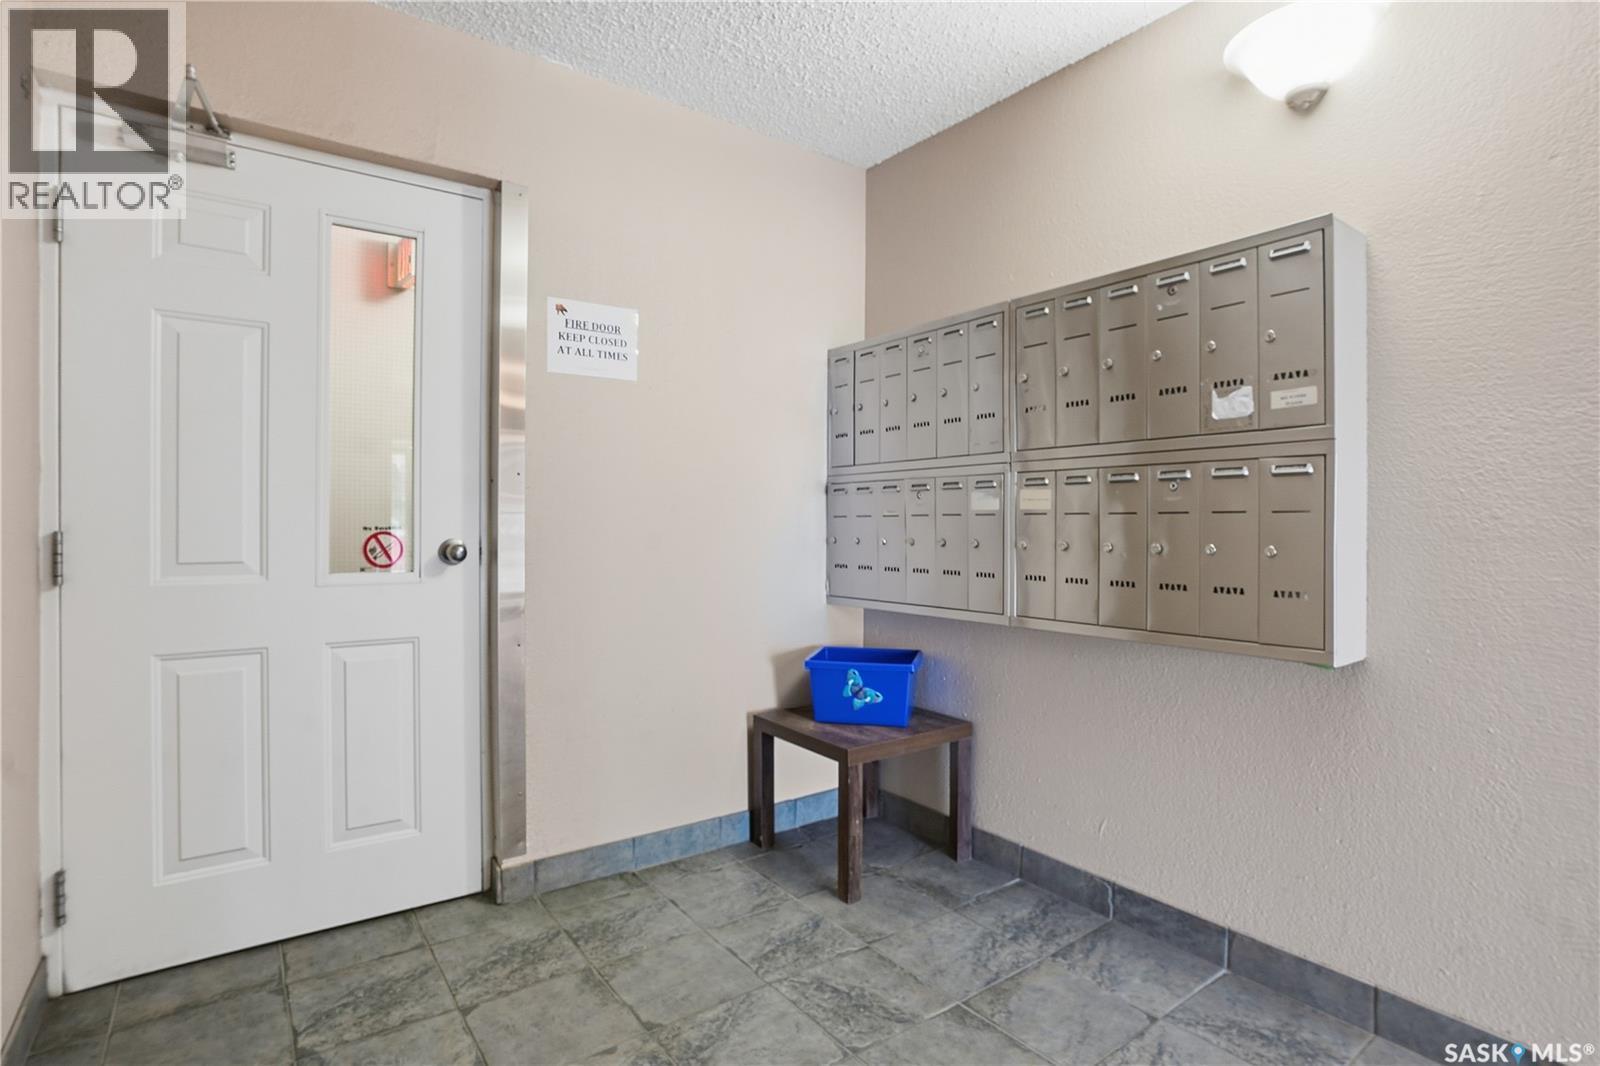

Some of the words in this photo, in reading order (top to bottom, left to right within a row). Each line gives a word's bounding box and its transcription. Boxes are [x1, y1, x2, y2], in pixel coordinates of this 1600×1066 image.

[565, 318, 590, 331] FIRE
[591, 321, 621, 335] DOOR
[558, 331, 586, 343] KEEP
[588, 335, 628, 348] CLOSED
[557, 345, 572, 356] AT
[574, 347, 595, 358] ALL
[597, 350, 629, 361] TIMES
